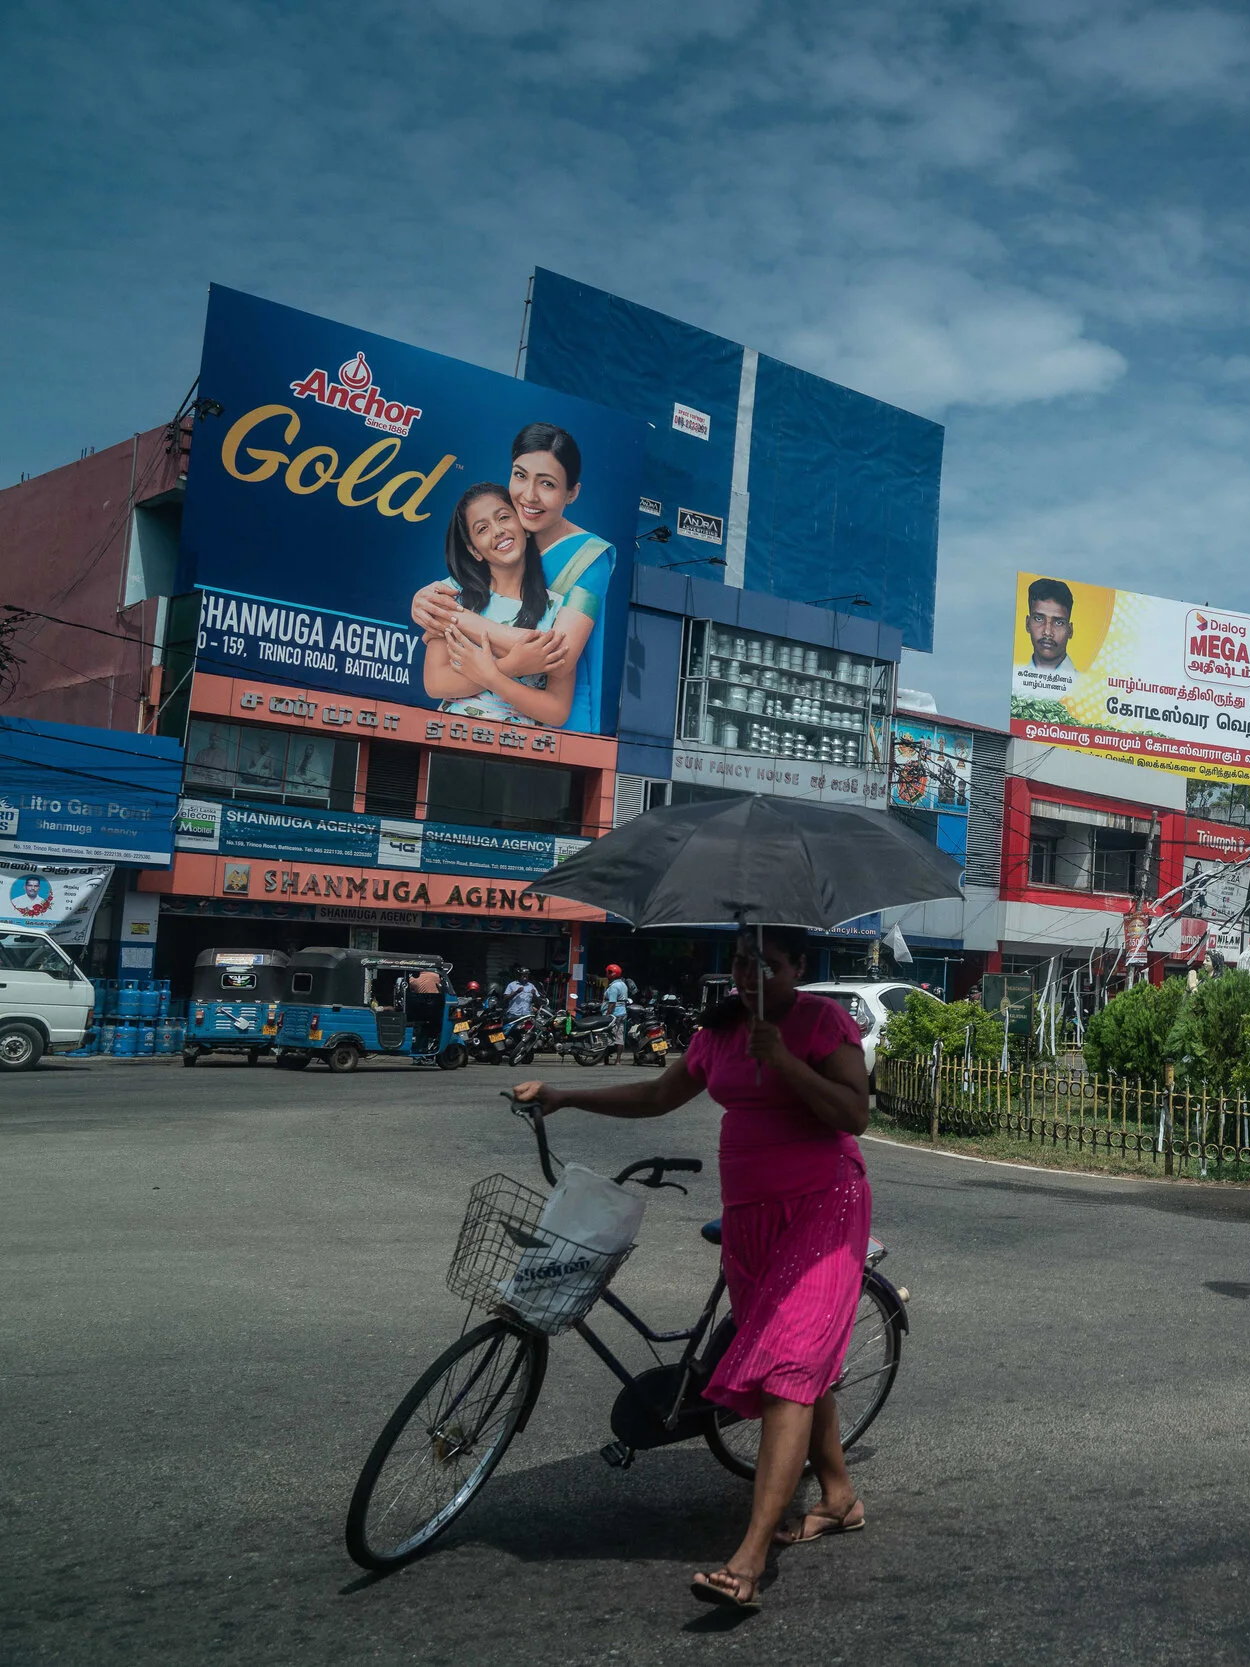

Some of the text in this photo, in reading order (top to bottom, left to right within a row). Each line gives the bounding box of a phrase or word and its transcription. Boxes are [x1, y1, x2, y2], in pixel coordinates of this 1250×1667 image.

[292, 369, 421, 427] Anchor
[366, 418, 408, 436] Since 1886
[221, 404, 457, 522] Gold
[683, 513, 718, 532] ANDRA
[201, 594, 418, 665] SHANMUGA AGENCY
[1210, 620, 1247, 638] Dialog
[223, 635, 247, 658] 159,
[259, 641, 301, 666] TRINCO
[304, 650, 339, 673] ROAD,
[345, 658, 410, 685] BATTICALOA
[1190, 635, 1250, 664] MEGA
[1094, 734, 1141, 754] வாரமும்
[675, 755, 800, 785] SUN FANCY HOUSE
[20, 795, 153, 822] Litro Gas Point
[178, 808, 217, 821] elecom
[36, 819, 92, 835] Shanmuga
[226, 810, 313, 830] SHANMUGA
[317, 819, 378, 836] AGENCY
[390, 840, 416, 853] 4G
[426, 831, 499, 848] SHANMUGA
[501, 839, 552, 852] AGENCY
[1197, 829, 1237, 854] Triumph
[264, 869, 551, 912] SHANMUGA AGENCY
[320, 907, 377, 920] SHANMUGA
[380, 911, 418, 923] AGENCY
[1217, 935, 1241, 944] NILAM
